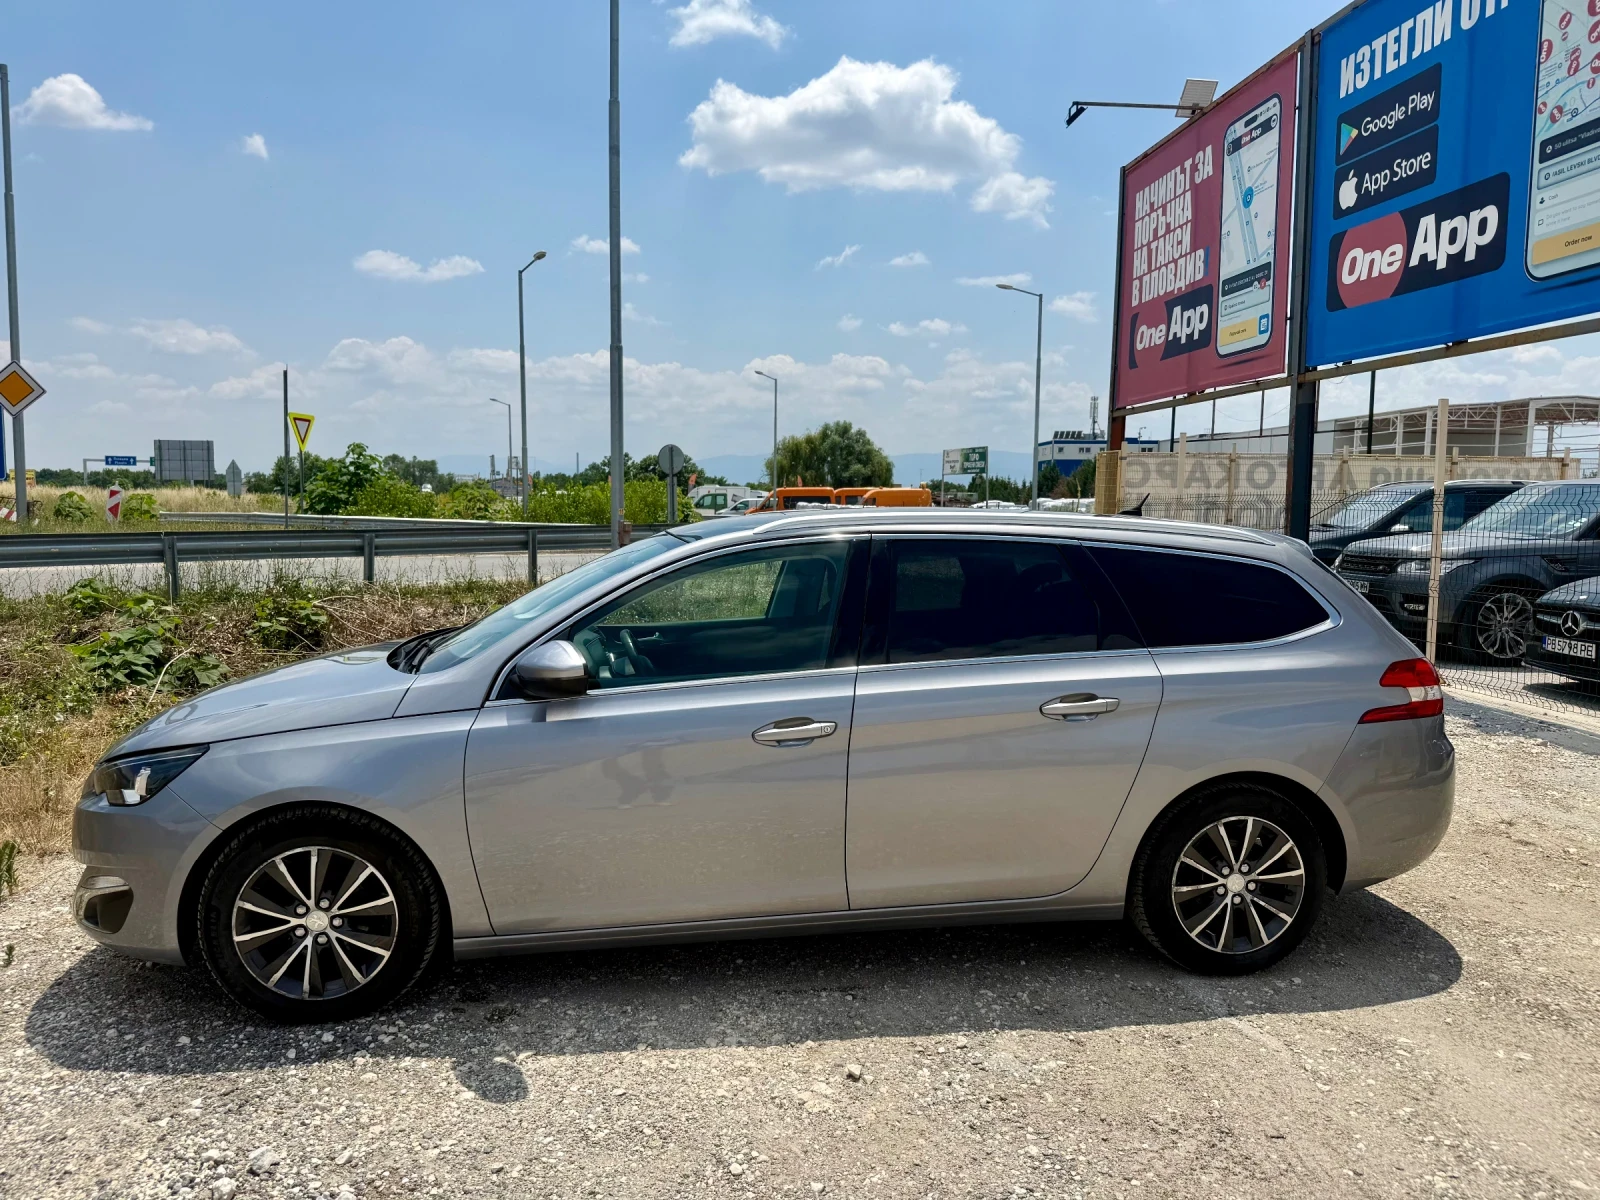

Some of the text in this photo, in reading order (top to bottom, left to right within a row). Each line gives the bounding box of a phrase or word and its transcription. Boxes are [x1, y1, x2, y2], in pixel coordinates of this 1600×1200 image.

[1339, 0, 1453, 99] ИЗТЕГЛИ
[1361, 90, 1436, 137] Google Play
[1135, 157, 1193, 221] НАЧИНЪТ
[1194, 144, 1213, 185] ЗА
[1361, 151, 1432, 195] App Store
[1134, 189, 1192, 250] ПОРЪЧКА
[1341, 204, 1499, 285] One App
[1564, 235, 1593, 247] Order now
[1132, 221, 1191, 279] НА ТАКСИ
[1131, 279, 1140, 308] В
[1136, 303, 1209, 351] One App
